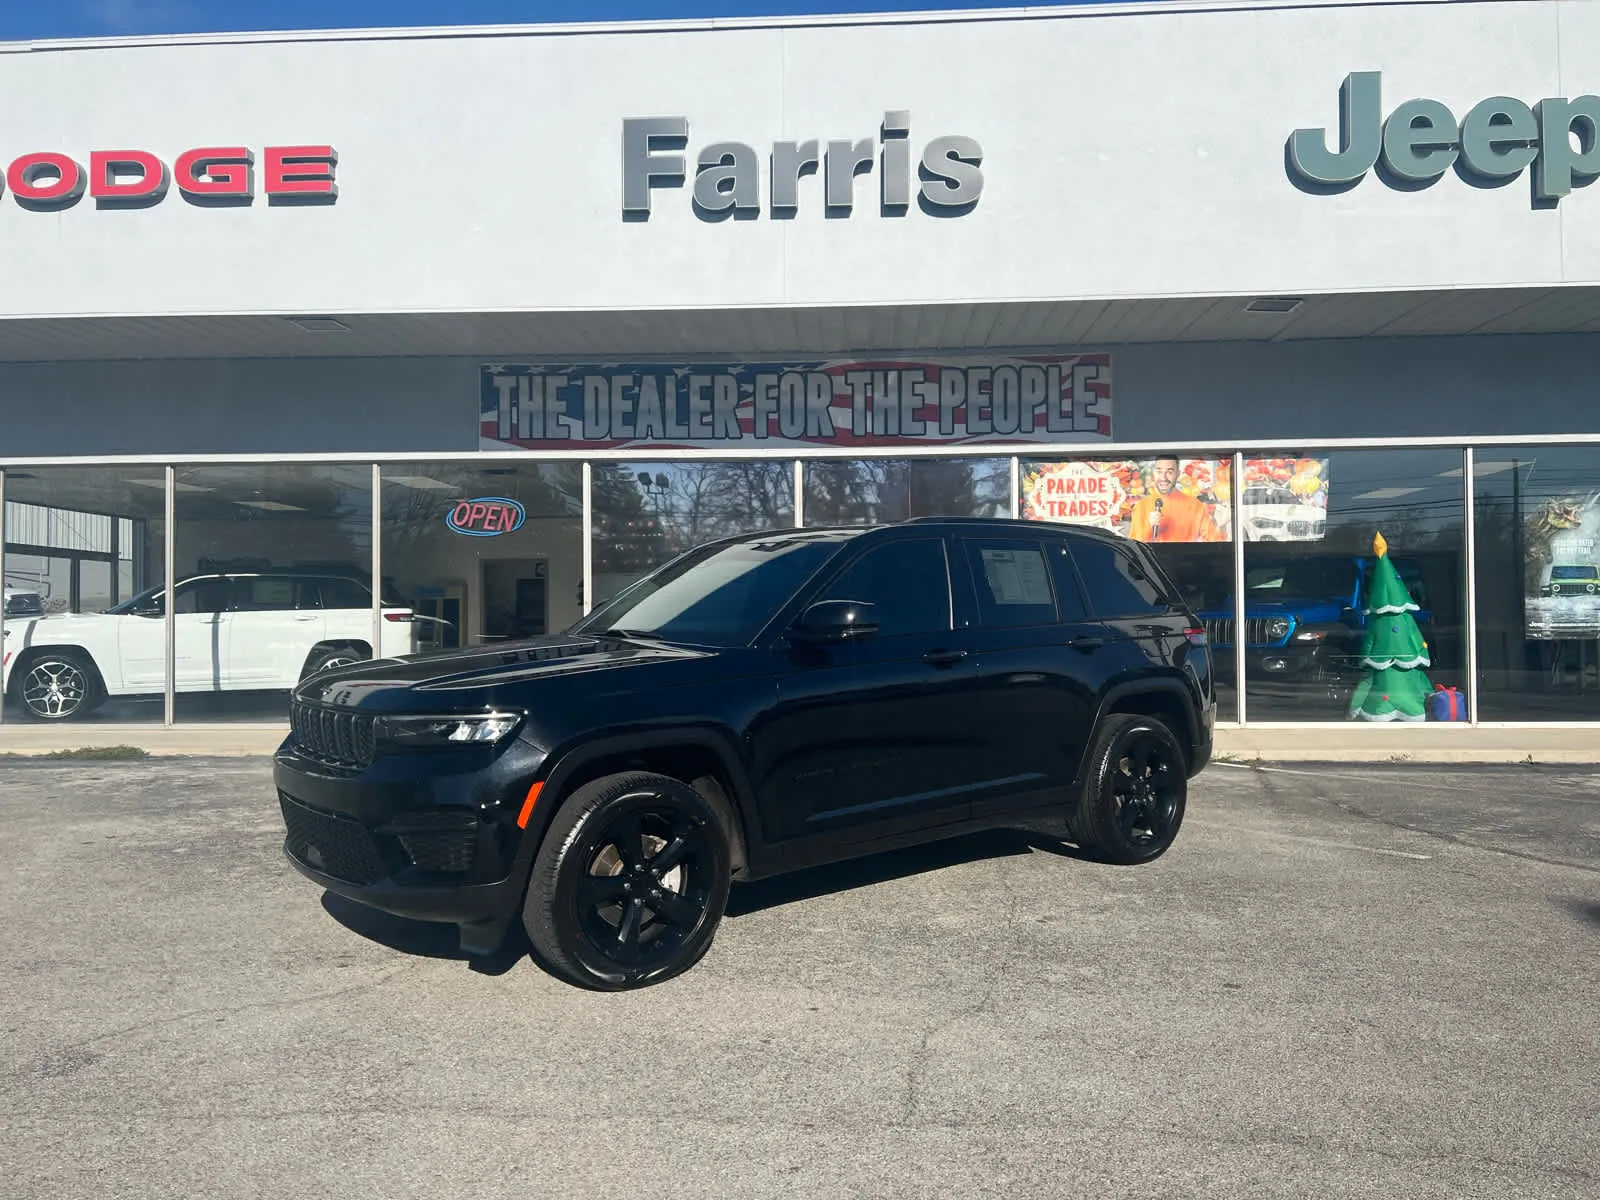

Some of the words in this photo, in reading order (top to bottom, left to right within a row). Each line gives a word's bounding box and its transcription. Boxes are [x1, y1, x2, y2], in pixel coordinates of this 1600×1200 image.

[622, 110, 985, 221] Farris
[1285, 71, 1600, 209] Jeep
[0, 145, 337, 208] ODGE
[493, 373, 571, 440] THE
[583, 373, 743, 440] DEALER
[755, 370, 836, 439] FOR
[846, 368, 926, 437] THE
[939, 364, 1099, 435] PEOPLE
[453, 502, 517, 532] OPEN
[1046, 477, 1108, 494] PARADE
[1046, 500, 1108, 517] TRADES
